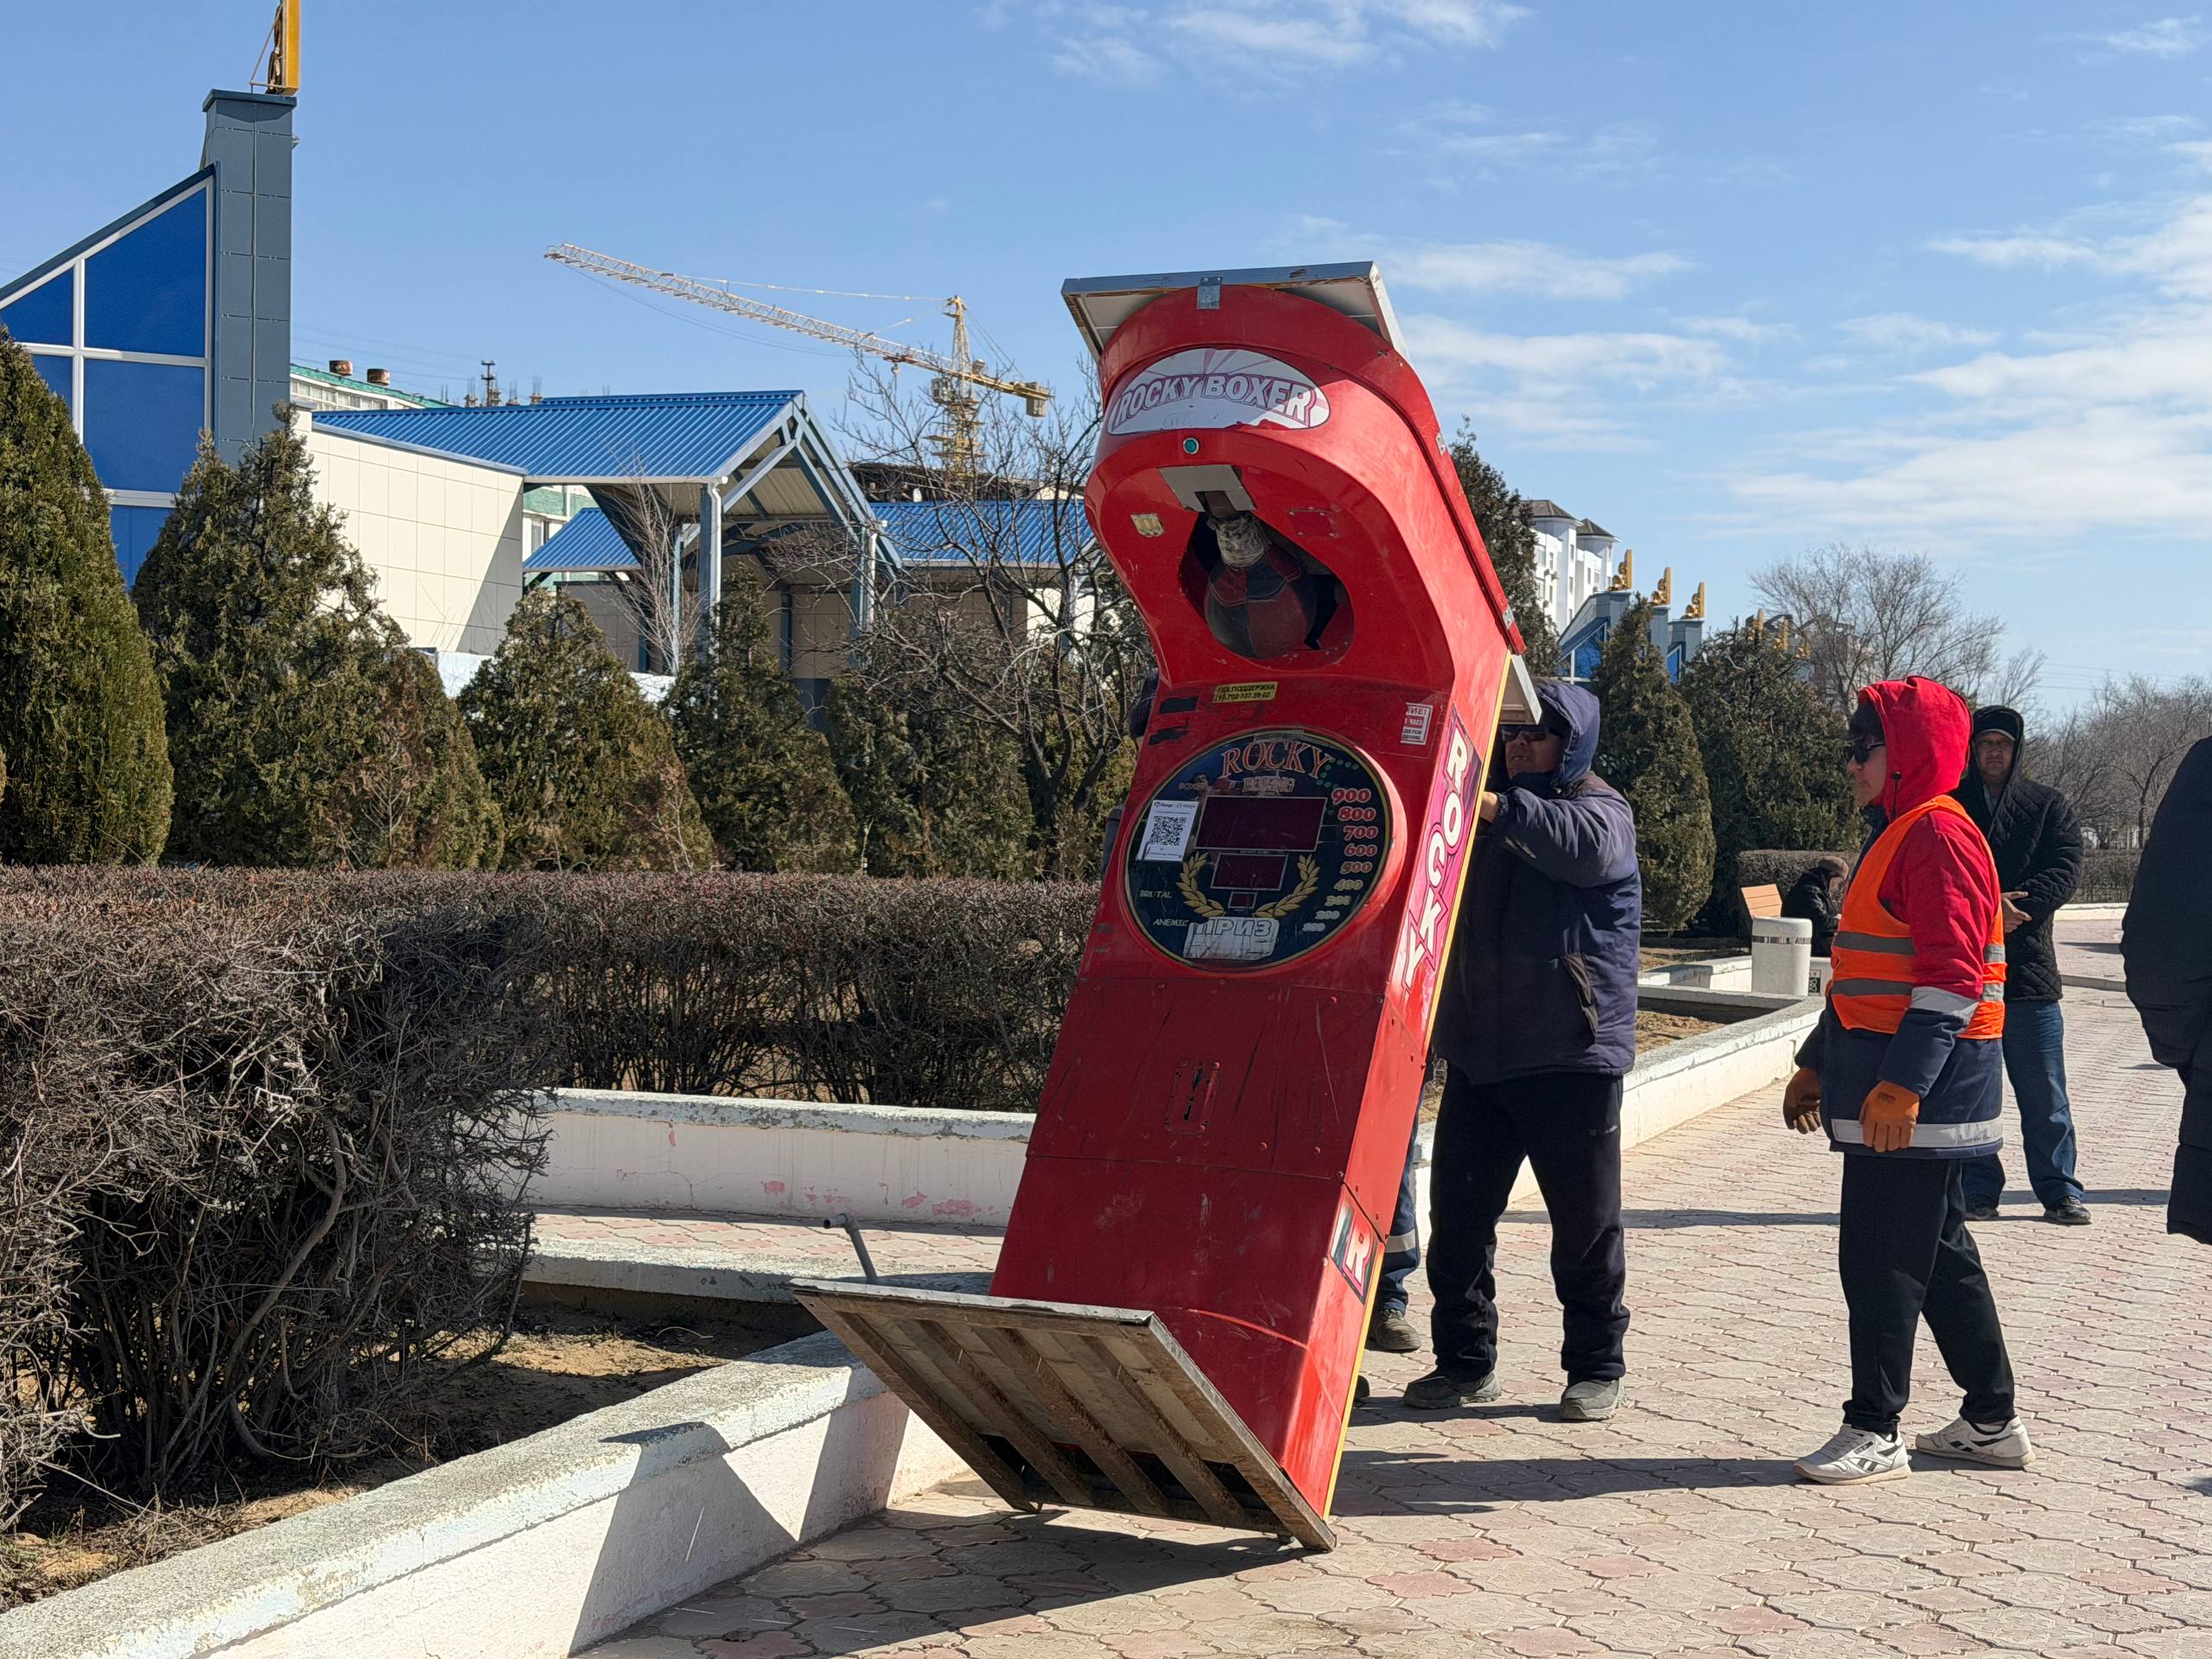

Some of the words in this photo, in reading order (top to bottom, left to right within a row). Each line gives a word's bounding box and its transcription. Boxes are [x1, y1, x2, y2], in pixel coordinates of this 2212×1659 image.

[1112, 375, 1199, 430] ROCKY
[1205, 373, 1313, 427] BOXER
[1217, 741, 1336, 779] ROCKY
[1332, 788, 1371, 804] 900
[1338, 806, 1376, 821] 800
[1343, 826, 1379, 841] 700
[1344, 843, 1378, 856] 600
[1402, 724, 1469, 991] ROCKY
[1339, 861, 1373, 874] 500
[1333, 879, 1363, 891] 400
[1140, 890, 1173, 899] BRUTAL
[1153, 918, 1189, 927] ANEMIC
[1199, 918, 1272, 937] ПРИЗ
